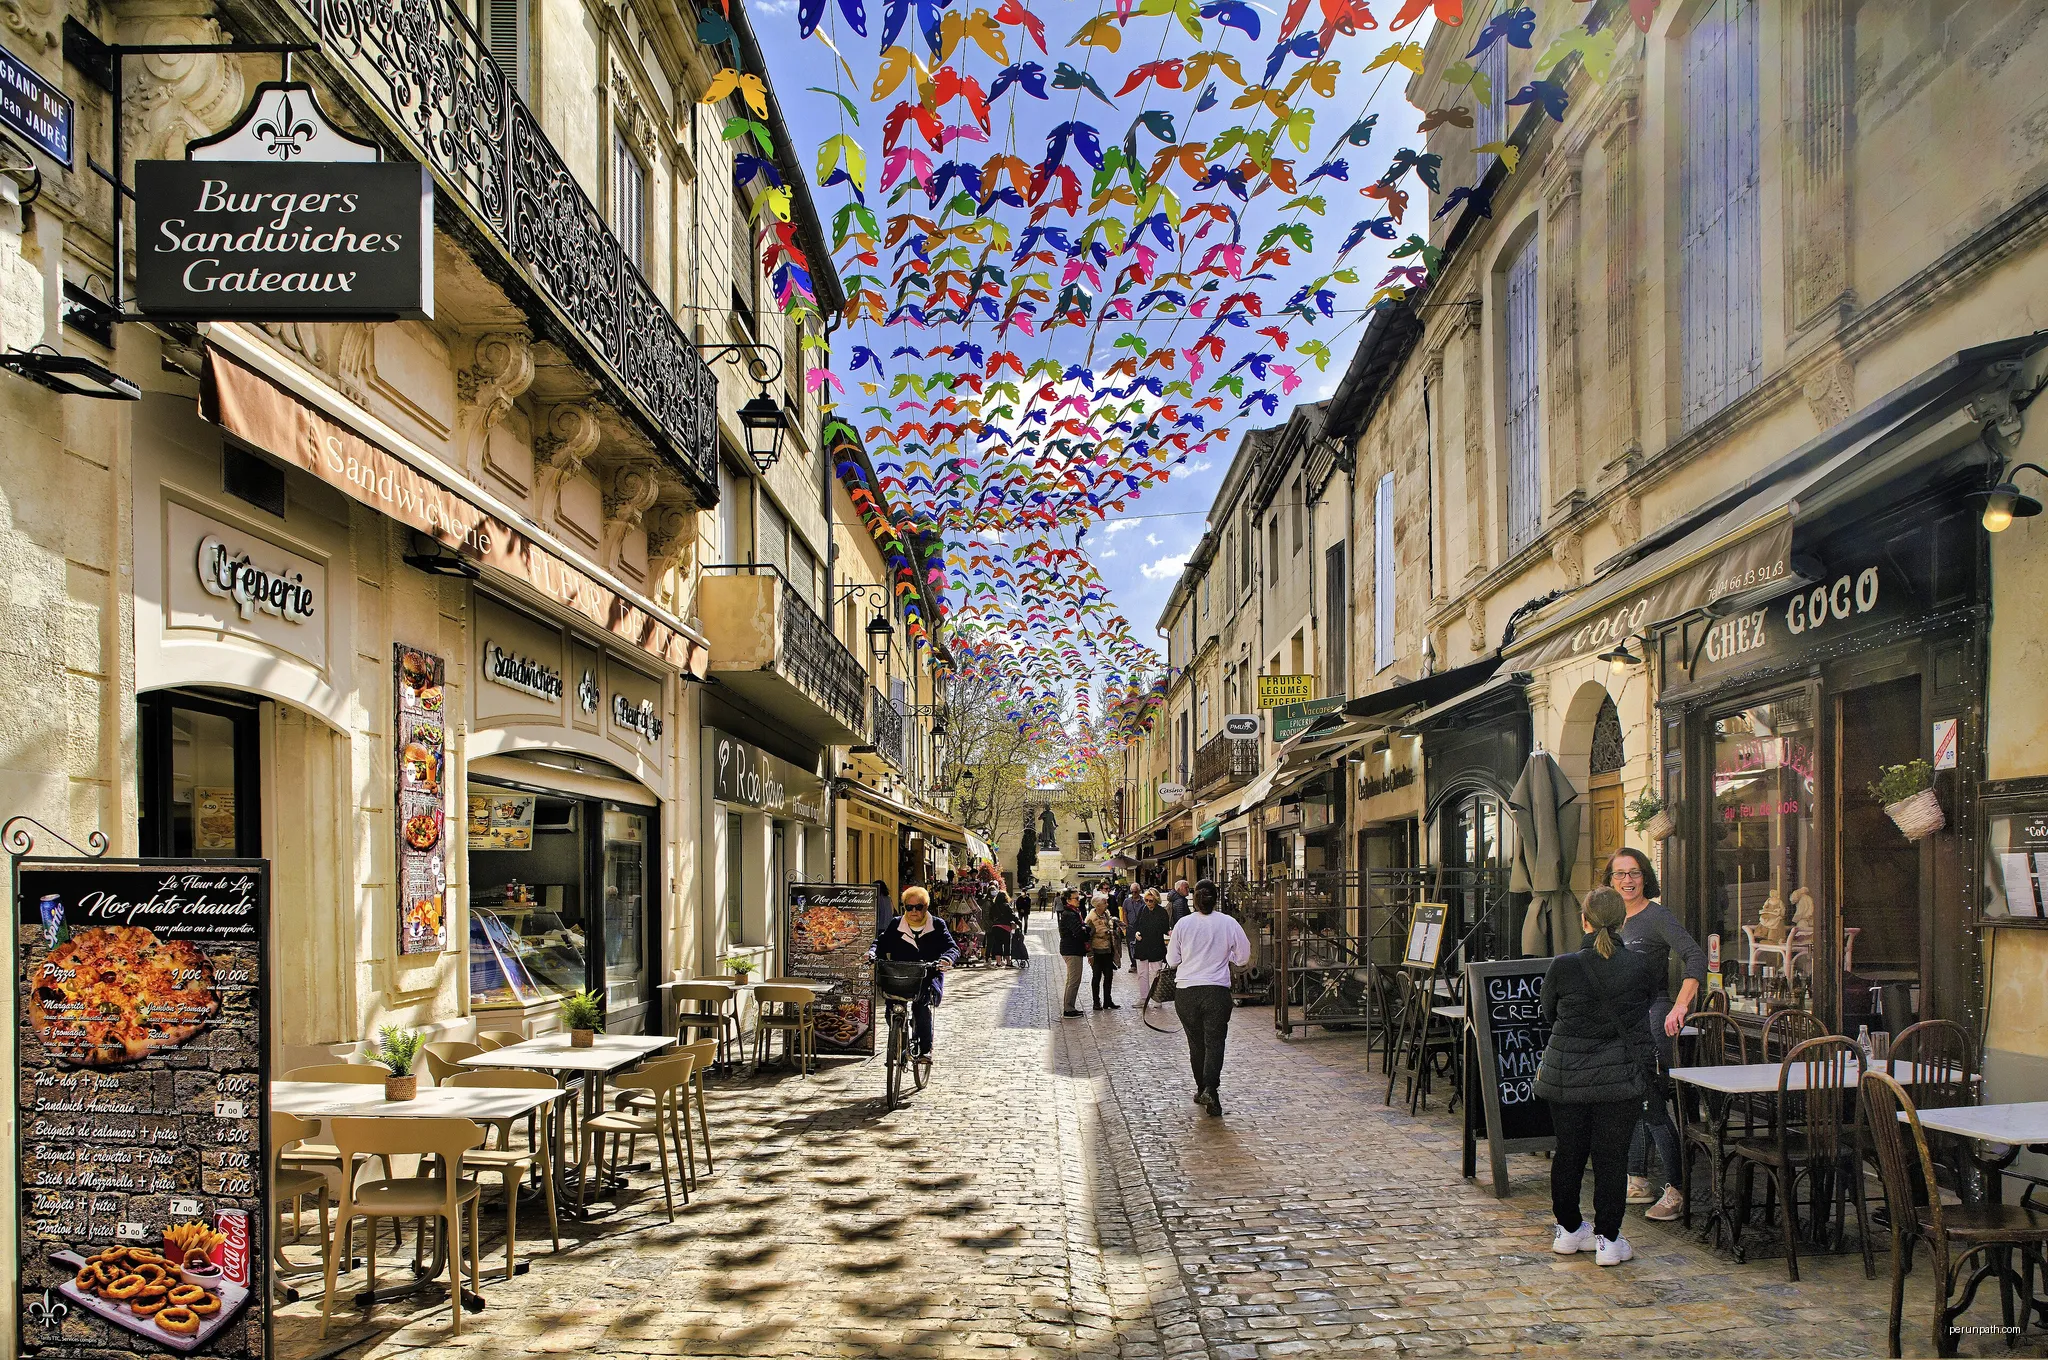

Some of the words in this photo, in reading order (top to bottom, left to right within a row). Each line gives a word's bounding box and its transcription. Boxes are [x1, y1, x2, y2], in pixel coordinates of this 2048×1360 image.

[43, 92, 64, 123] RUE
[26, 110, 67, 152] JAURÈS
[194, 179, 359, 230] Burgers
[154, 219, 402, 253] Sandwiches
[182, 259, 357, 292] Gateaux
[326, 436, 492, 554] Sandwicherie
[529, 547, 604, 623] FLEUR
[619, 602, 643, 643] DE
[655, 625, 685, 666] LYS
[213, 544, 315, 617] Crêperie
[1730, 574, 1742, 590] 66
[1758, 565, 1771, 582] 91
[1705, 607, 1769, 663] CHEZ
[1785, 566, 1879, 635] COCO
[495, 646, 564, 699] Sandwicherie
[1266, 676, 1303, 685] FRUITS
[1261, 685, 1308, 695] LEGUMES
[1287, 705, 1296, 719] Le
[736, 743, 746, 799] R
[1160, 787, 1183, 795] Casino
[1760, 800, 1771, 816] de
[158, 875, 179, 892] La
[181, 874, 213, 891] Fleur
[213, 877, 228, 889] de
[229, 875, 255, 896] Lys
[78, 890, 131, 918] Nos
[126, 894, 187, 925] plats
[182, 895, 254, 915] chauds
[167, 922, 193, 937] place
[43, 963, 77, 983] Pizza
[214, 969, 249, 981] 10.00€
[43, 999, 85, 1012] Margarita
[177, 1003, 211, 1016] Fromage
[44, 1026, 51, 1036] 3
[52, 1026, 87, 1039] fromages
[147, 1029, 170, 1039] Reine
[1492, 1028, 1552, 1053] TART
[34, 1071, 78, 1092] Hot-dog
[82, 1074, 91, 1086] +
[93, 1074, 119, 1092] frites
[217, 1078, 250, 1092] 6.00€
[35, 1097, 85, 1112] Sandwich
[85, 1098, 135, 1114] Américain
[35, 1121, 76, 1140] Beignets
[79, 1122, 90, 1137] de
[93, 1124, 136, 1138] calamars
[140, 1125, 149, 1138] +
[151, 1125, 178, 1145] frites
[217, 1128, 250, 1143] 6.50€
[35, 1145, 76, 1164] Beignets
[79, 1148, 91, 1161] de
[93, 1151, 132, 1163] crevettes
[136, 1150, 145, 1162] +
[148, 1150, 174, 1169] frites
[219, 1151, 250, 1168] 8.00€
[35, 1171, 63, 1185] Stick
[66, 1172, 77, 1186] de
[78, 1171, 134, 1192] Mozzarella
[138, 1175, 147, 1188] +
[149, 1175, 176, 1193] frites
[219, 1177, 251, 1193] 7.00€
[35, 1194, 75, 1215] Nuggets
[79, 1197, 88, 1210] +
[91, 1198, 117, 1216] frites
[35, 1219, 72, 1236] Portion
[75, 1221, 87, 1235] de
[89, 1222, 115, 1241] frites
